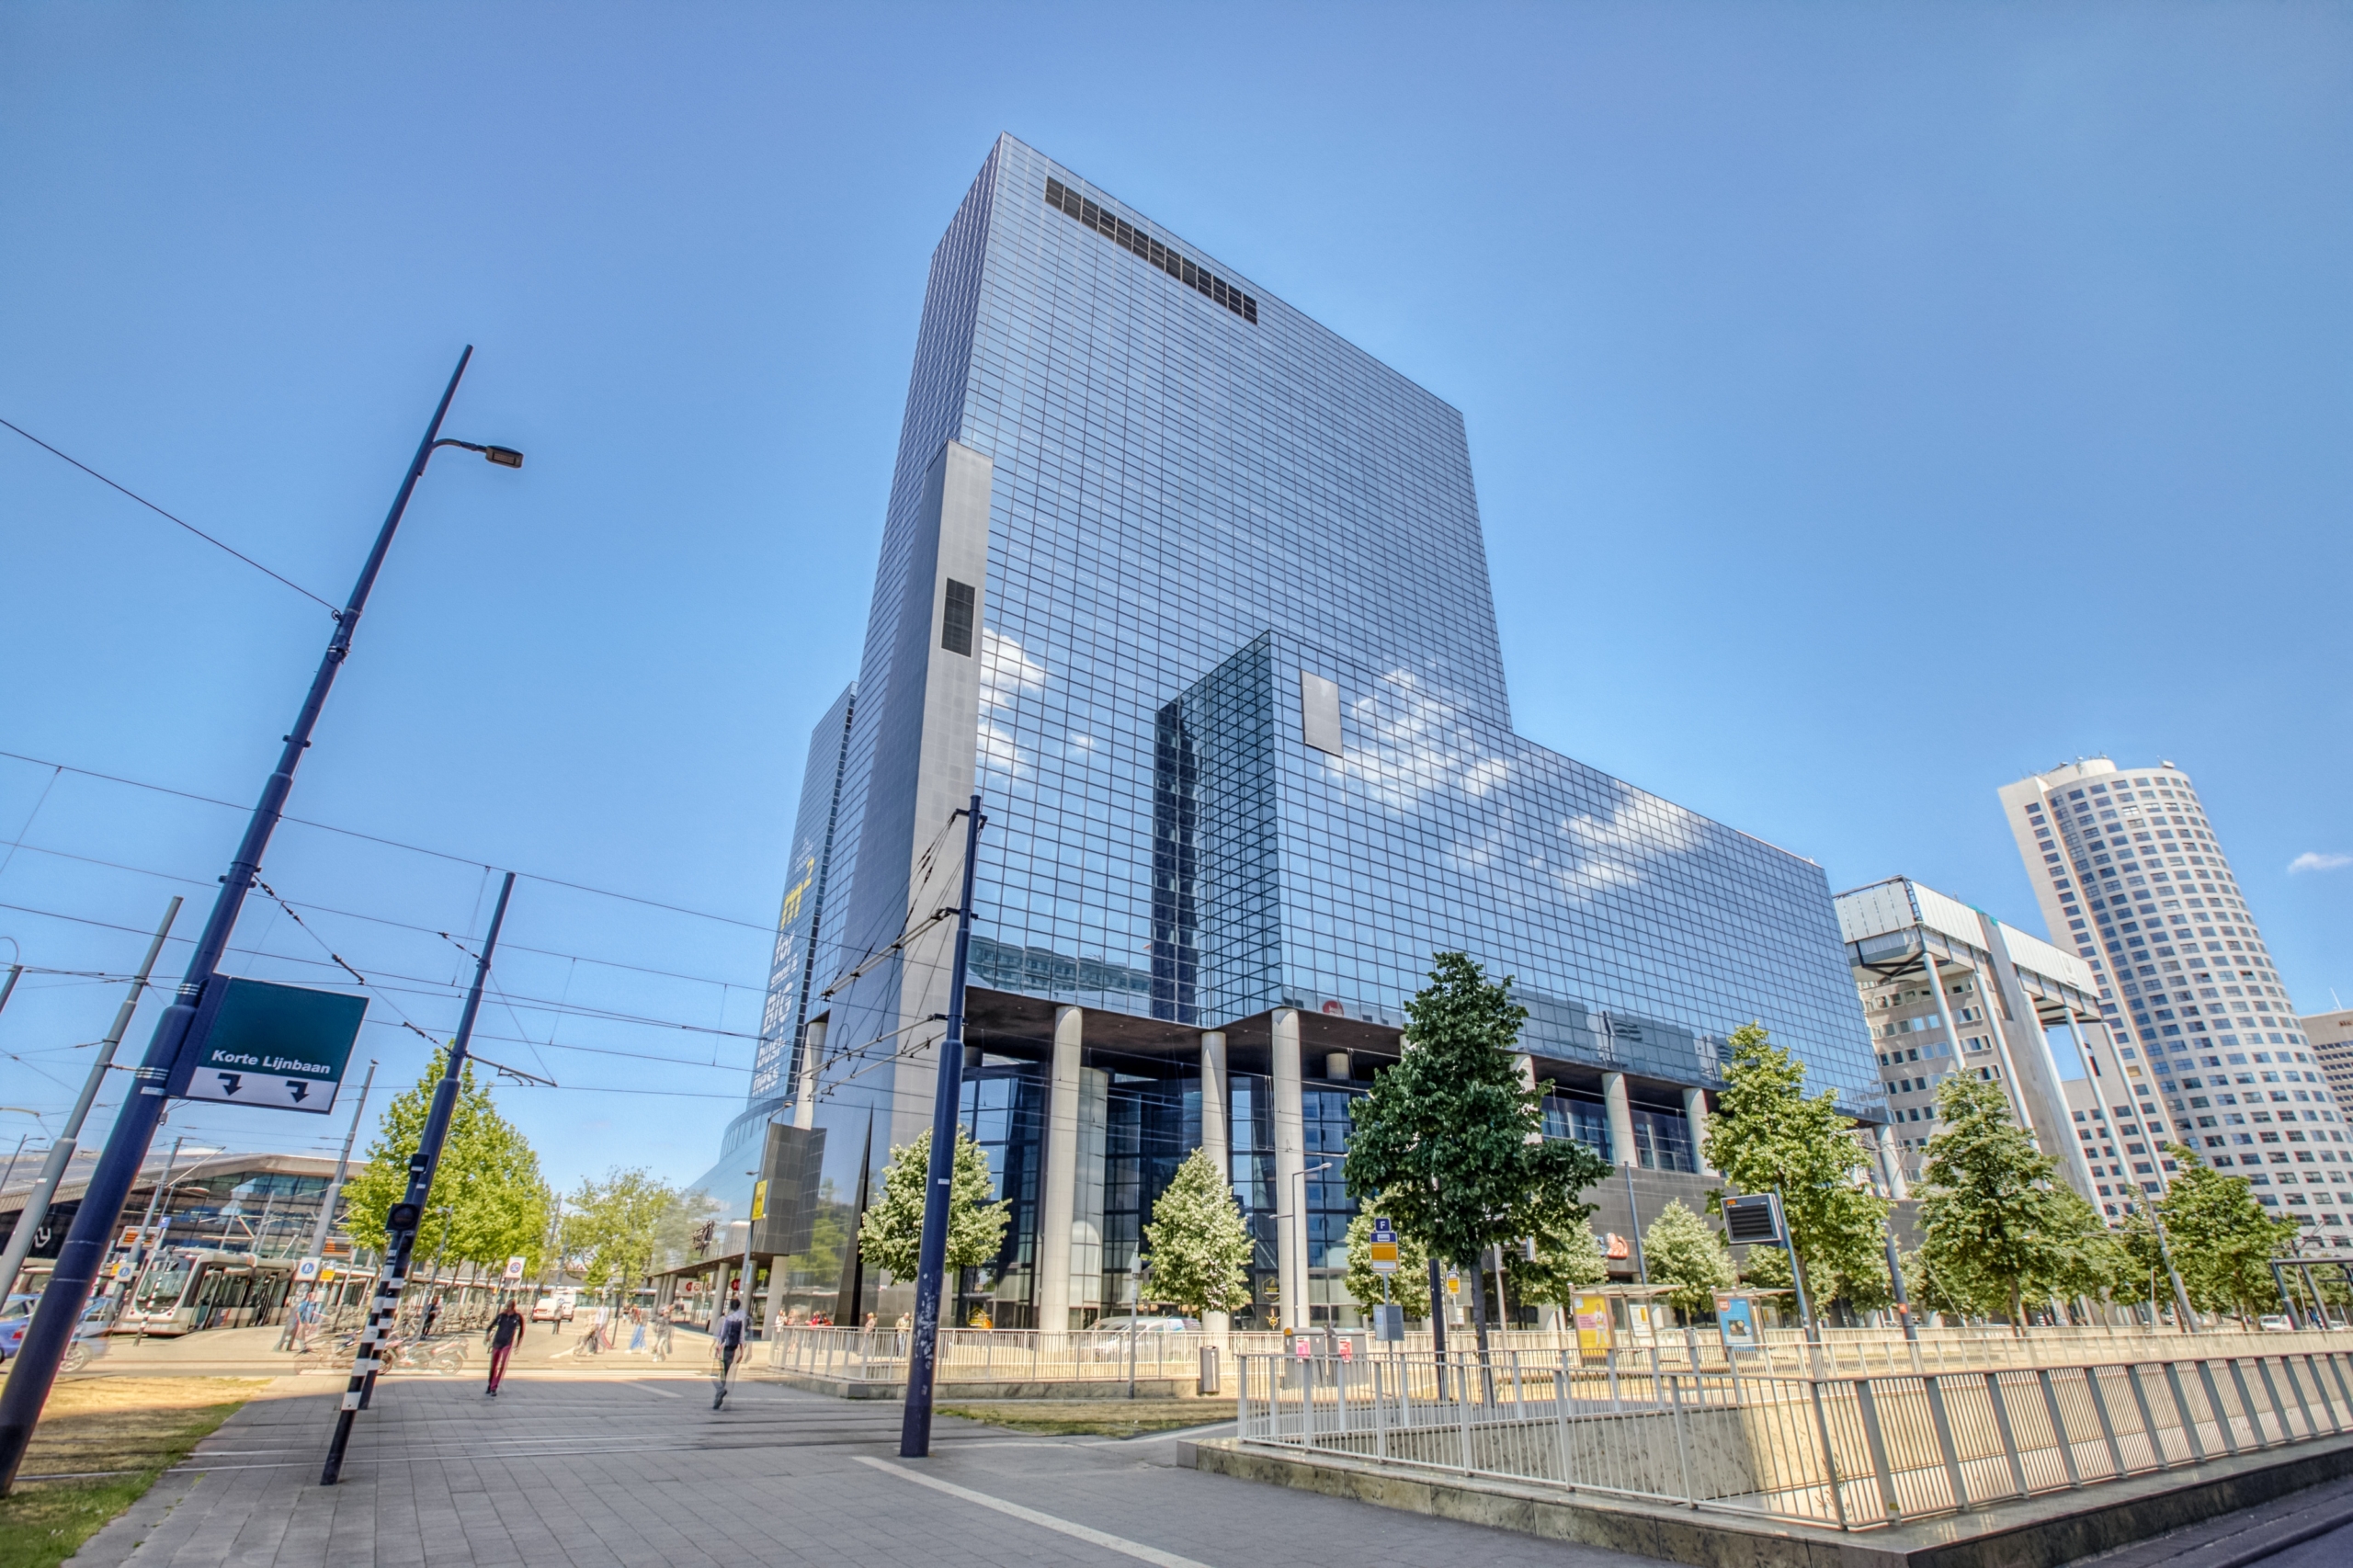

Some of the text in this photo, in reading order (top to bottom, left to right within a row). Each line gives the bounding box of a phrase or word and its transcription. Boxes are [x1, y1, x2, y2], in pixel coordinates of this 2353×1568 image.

[774, 929, 796, 966] for
[762, 982, 793, 1035] BIG
[211, 1050, 332, 1074] Korte Lijnbaan
[1380, 1221, 1386, 1230] F
